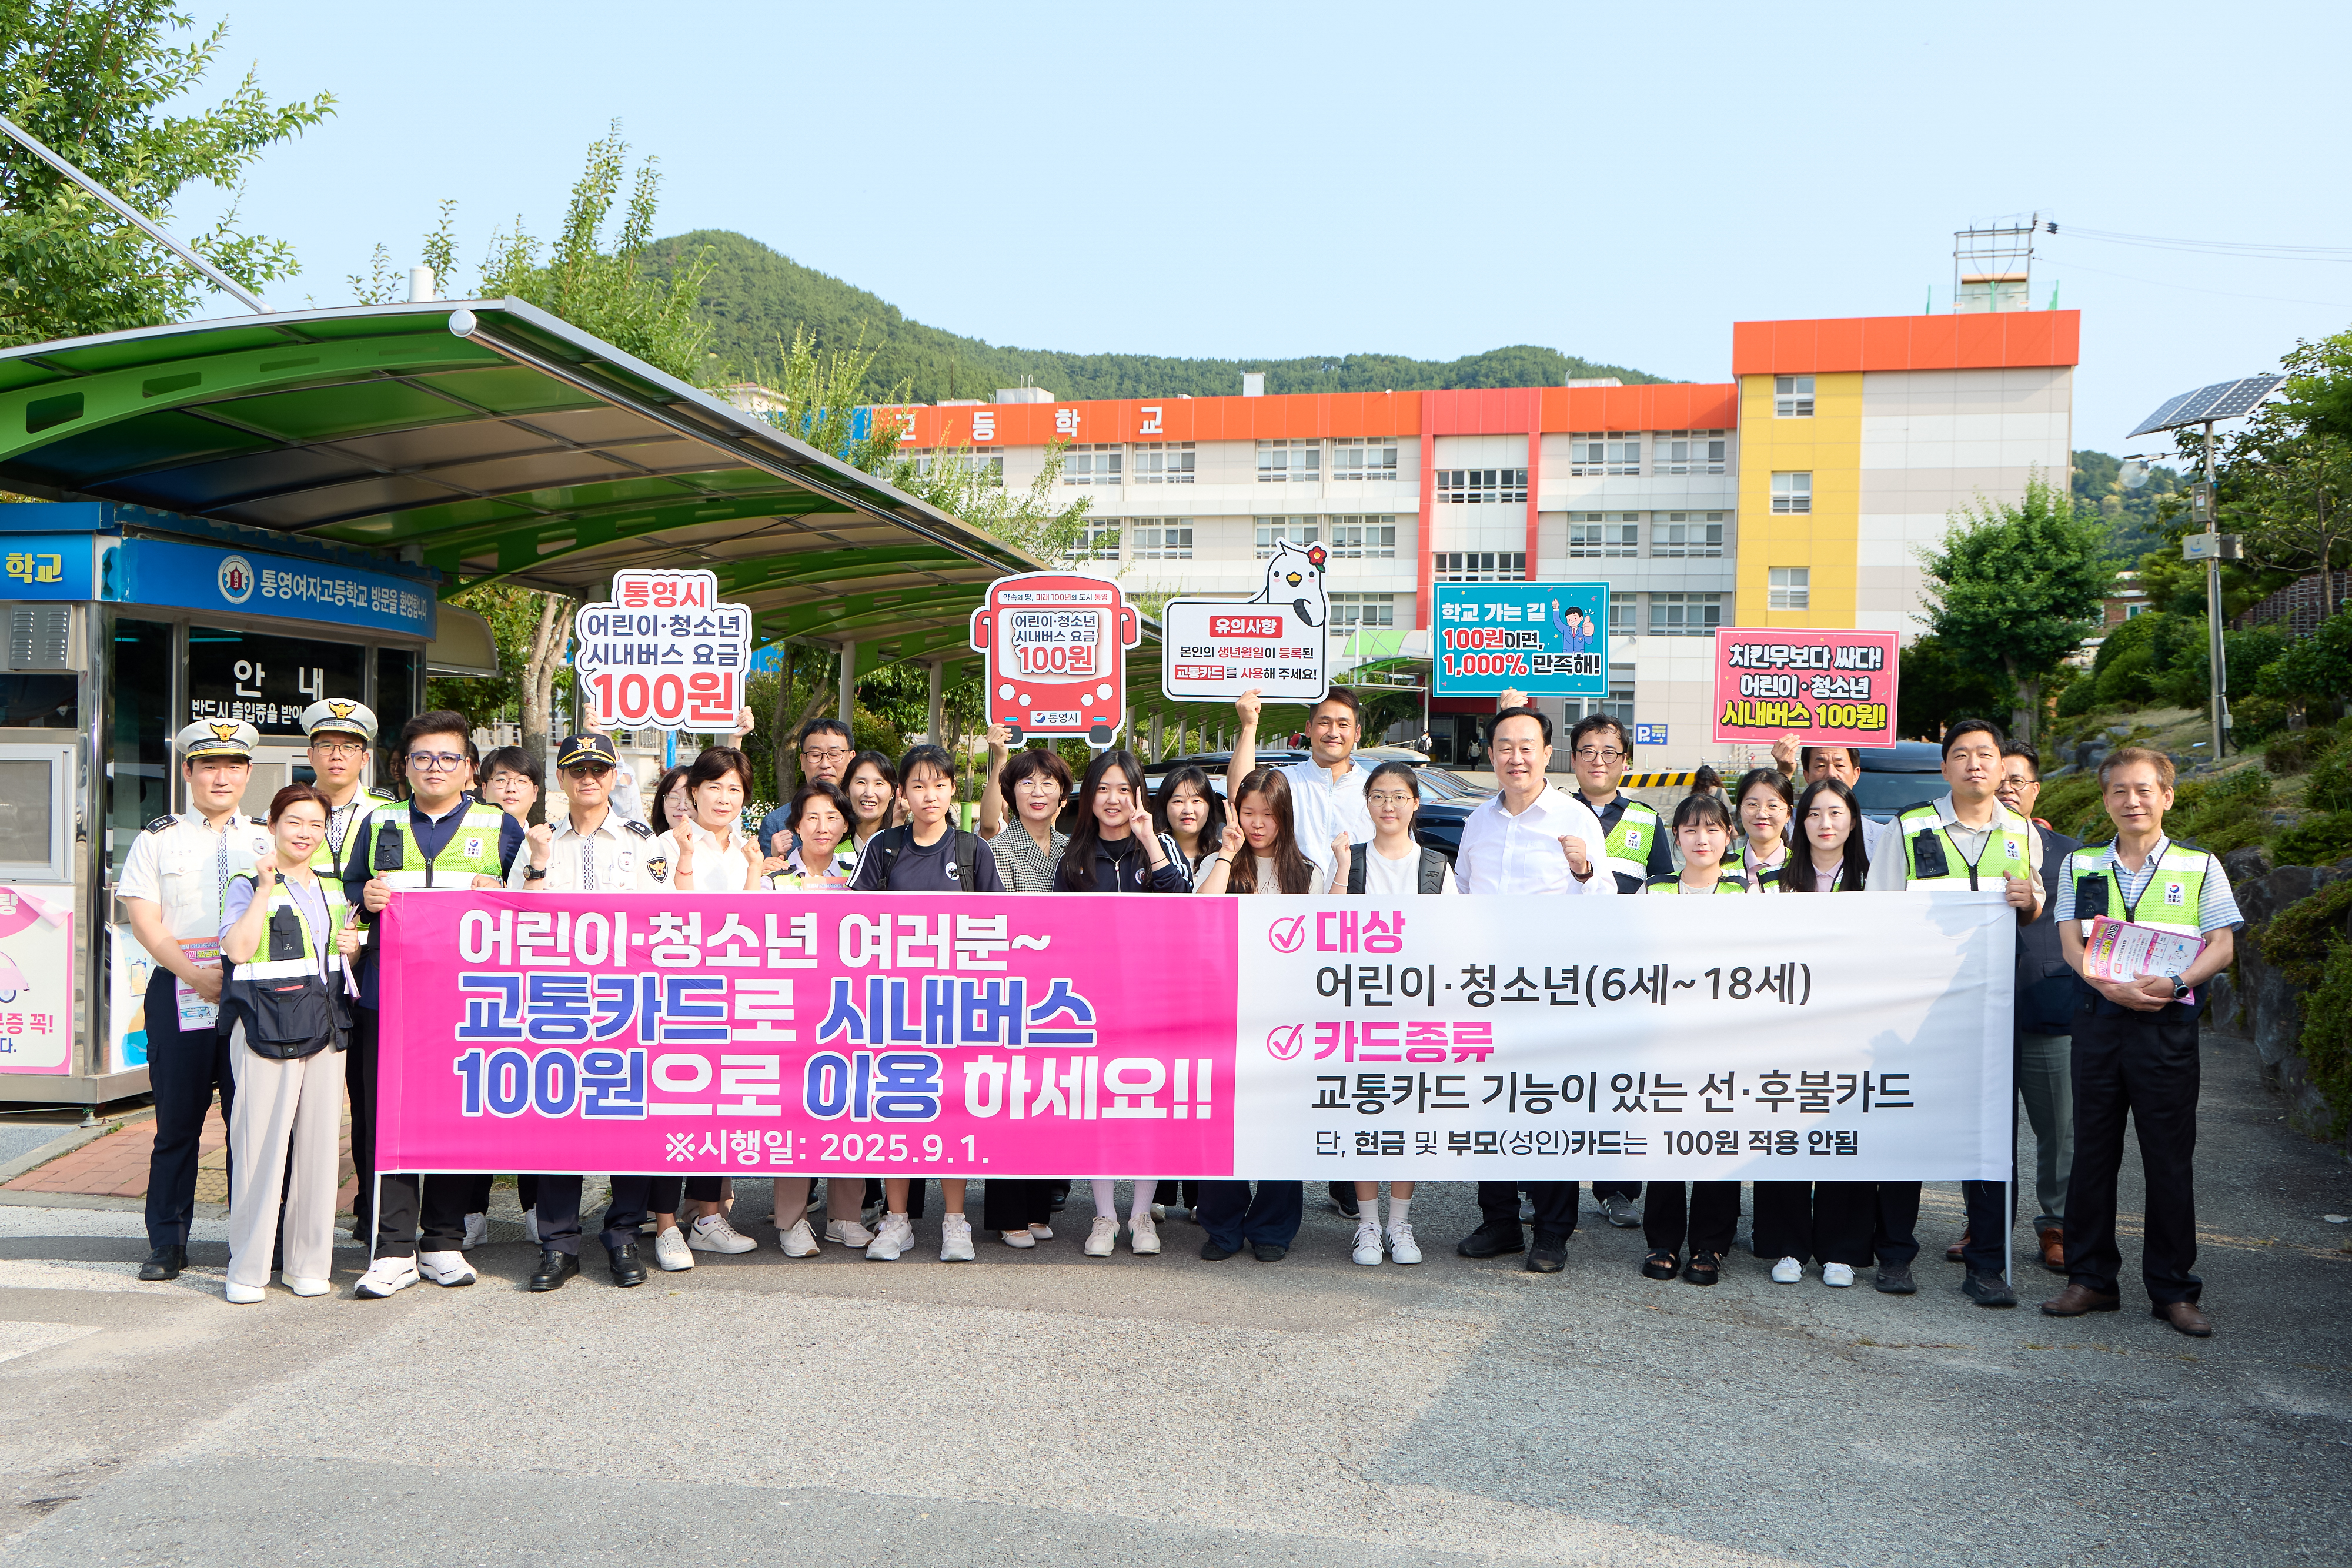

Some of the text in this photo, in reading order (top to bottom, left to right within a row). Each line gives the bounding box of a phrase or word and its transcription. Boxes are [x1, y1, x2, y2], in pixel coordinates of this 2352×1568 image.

[6, 553, 63, 583] 학교
[260, 569, 427, 621] 통영여자고등학교 방문을 환영합니다
[623, 581, 705, 608] 통영시
[1015, 616, 1095, 627] 어린이·청소년
[1442, 603, 1545, 622] 학교 가는 길
[588, 614, 740, 637] 어린이·청소년
[1015, 630, 1095, 643] 시내버스 요금
[1215, 618, 1277, 634] 유의사항
[1443, 628, 1544, 650] 100원이면,
[587, 643, 739, 666] 시내버스 요금
[1019, 646, 1093, 671] 100원
[1180, 646, 1314, 659] 본인의 생년월일이 등록된
[1443, 653, 1601, 677] 1,000% 만족해!
[1729, 644, 1883, 670] 치킨무보다 싸다!
[1241, 667, 1275, 679] 사용해
[1279, 668, 1317, 680] 주세요!
[593, 672, 733, 721] 100원
[192, 699, 229, 720] 반드시
[232, 701, 278, 724] 출입증을
[1048, 713, 1077, 723] 통영시
[1721, 700, 1887, 730] 시내버스 100원!
[459, 909, 1051, 971] 어린이·청소년 여러분~
[1316, 910, 1406, 954] 대상
[198, 949, 220, 958] 요금제
[2099, 938, 2114, 961] 요금제
[1316, 962, 1812, 1007] 어린이·청소년(6세~18세)
[455, 972, 1098, 1048] 교통카드로 시내버스
[0, 1012, 54, 1035] 증 꼭!
[1314, 1020, 1494, 1064] 카드종류
[453, 1047, 1213, 1123] 100원으로 이용 하세요!!
[1311, 1069, 1915, 1115] 교통카드 기능이 있는 선·후불카드
[820, 1133, 989, 1164] 2025.9.1.
[1316, 1129, 1859, 1158] 단, 현금 및 부모(성인)카드는 100원 적용 안됨
